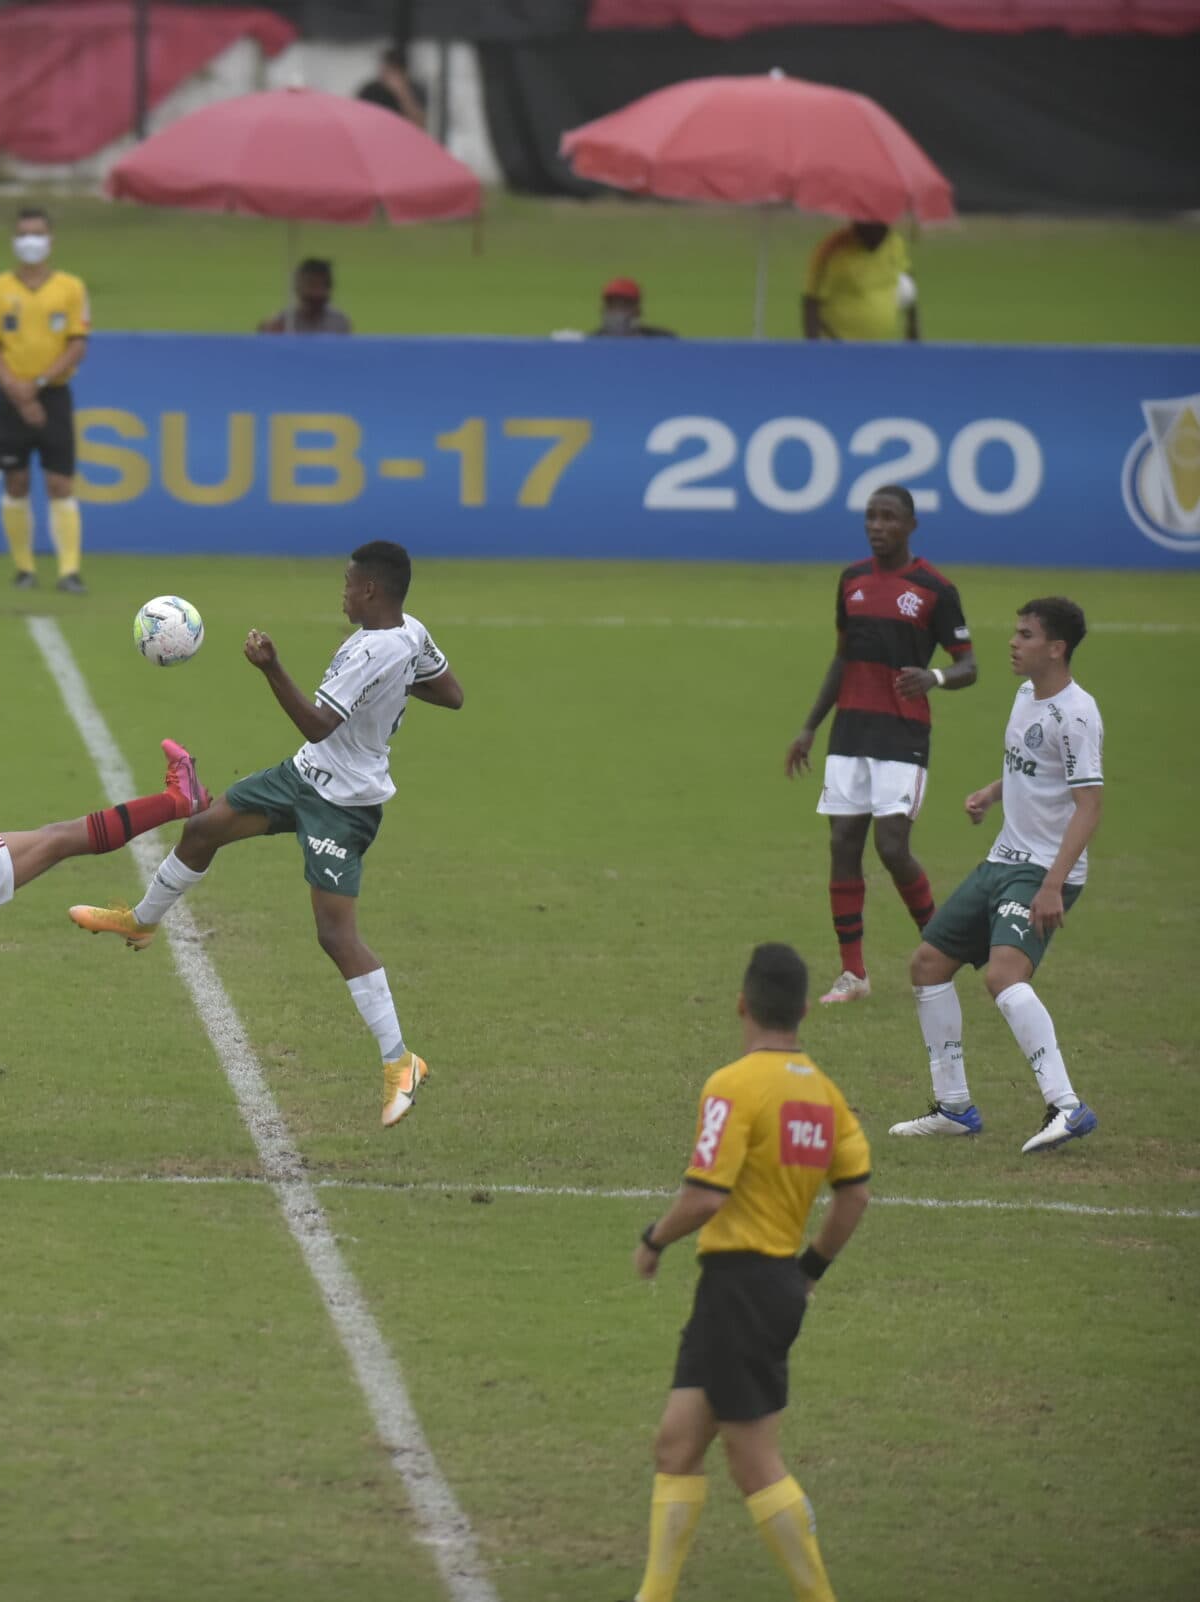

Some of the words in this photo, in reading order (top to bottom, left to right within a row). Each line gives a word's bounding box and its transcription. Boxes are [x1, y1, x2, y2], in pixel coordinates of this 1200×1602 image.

[72, 407, 592, 508] SUB-17
[643, 415, 1044, 514] 2020
[307, 835, 348, 860] refisa
[787, 1119, 827, 1149] TCL
